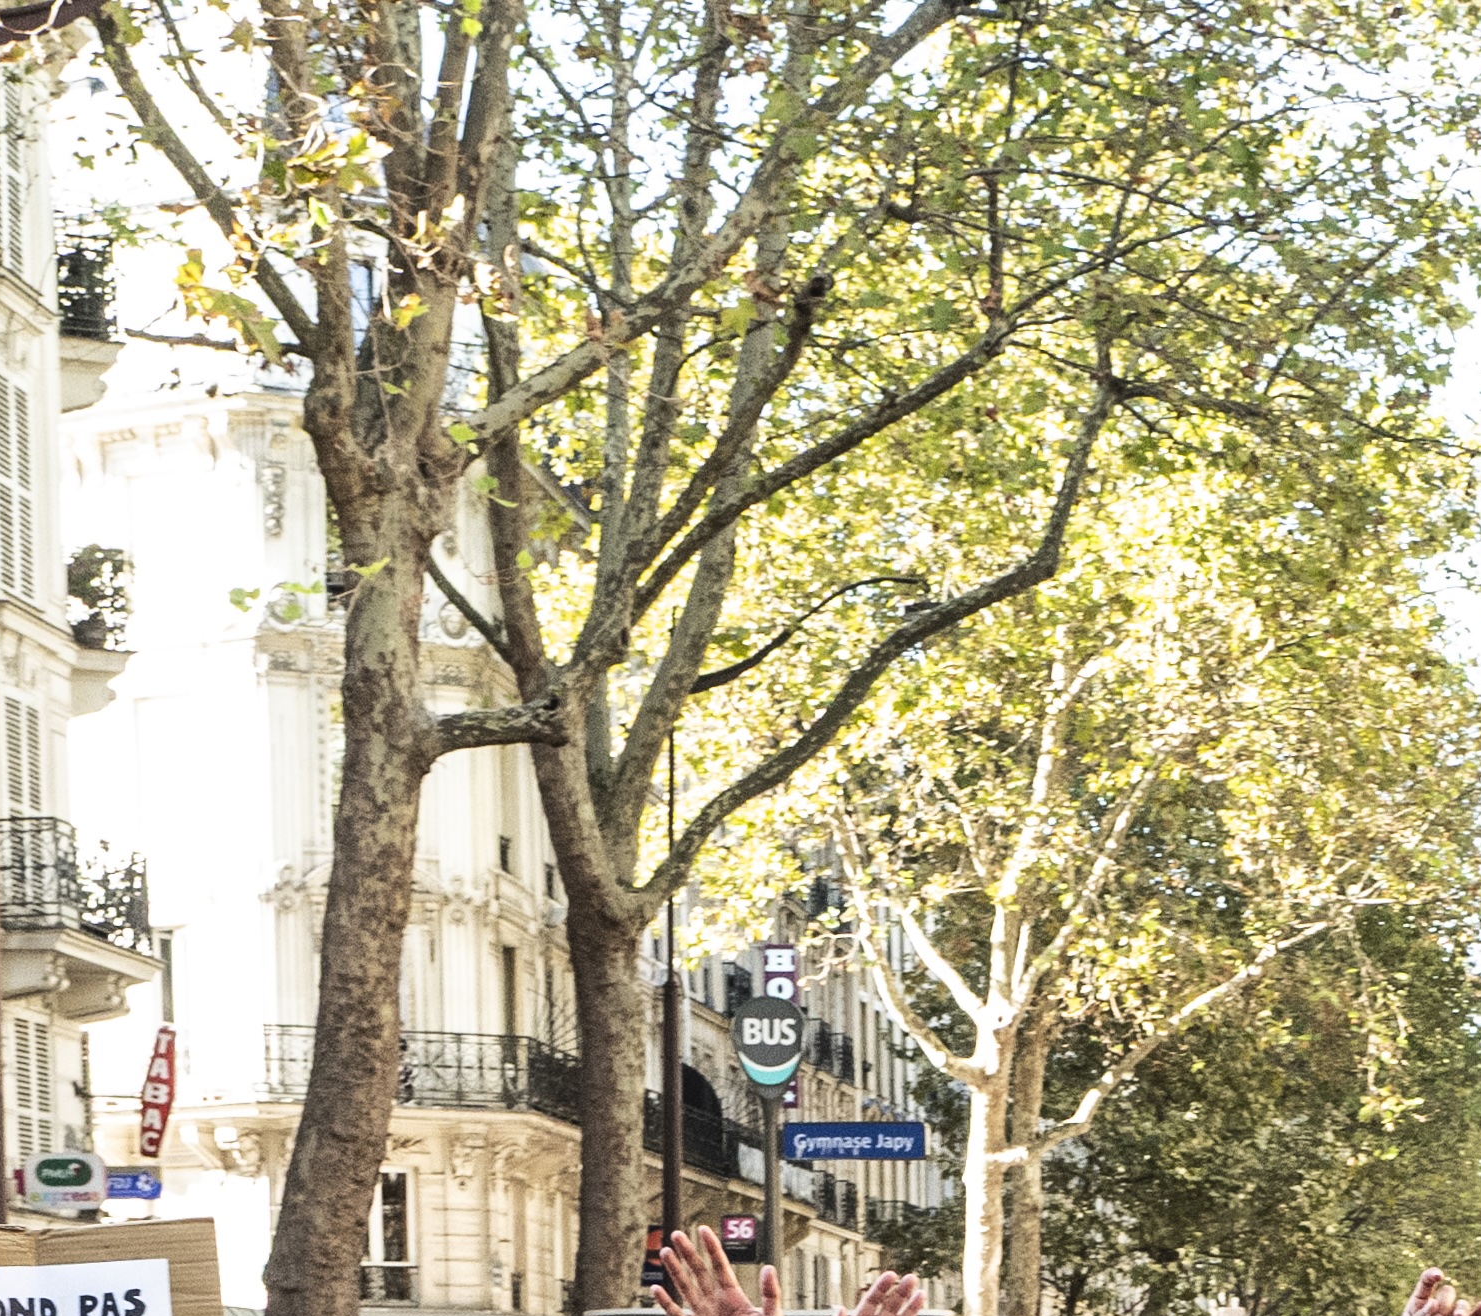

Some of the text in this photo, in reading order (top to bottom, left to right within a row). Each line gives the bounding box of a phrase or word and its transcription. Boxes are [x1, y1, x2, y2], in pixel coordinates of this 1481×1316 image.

[742, 1018, 797, 1046] BUS
[142, 1033, 171, 1152] TABAC
[793, 1133, 915, 1154] Gymnase Japy
[726, 1219, 753, 1240] 56
